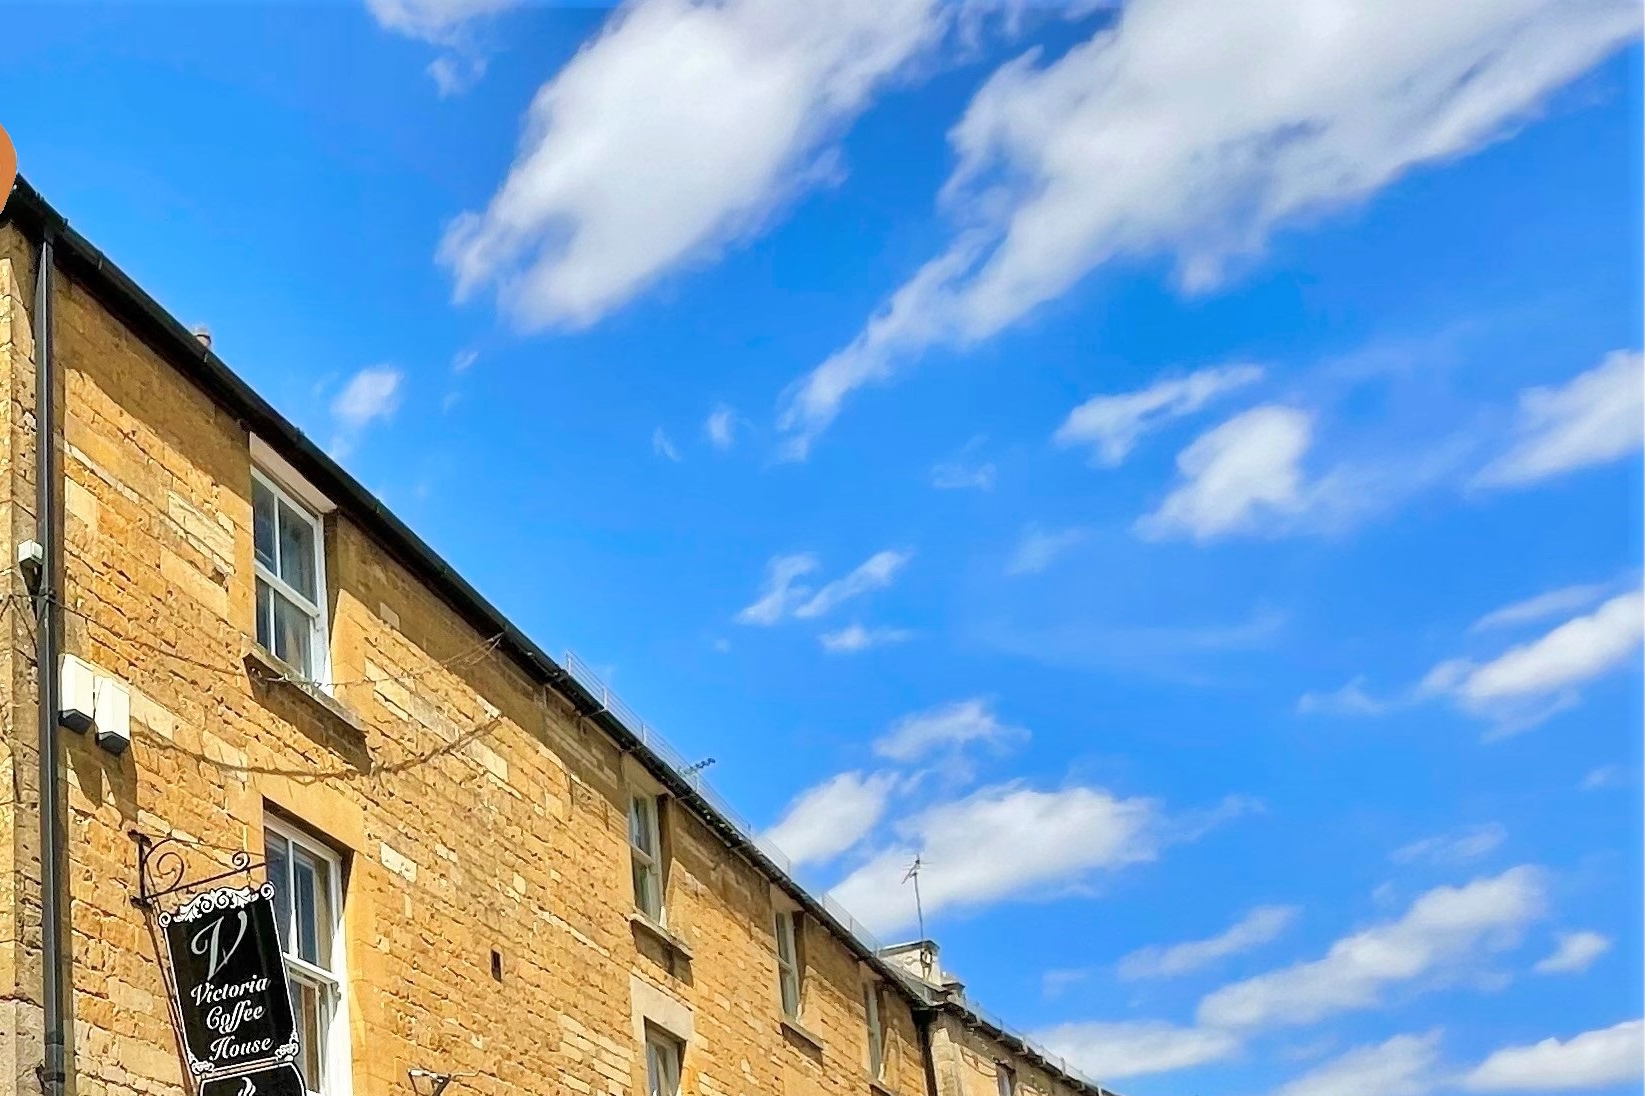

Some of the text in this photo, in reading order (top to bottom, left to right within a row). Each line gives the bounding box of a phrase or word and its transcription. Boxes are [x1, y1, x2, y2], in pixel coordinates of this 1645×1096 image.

[190, 974, 272, 1007] Victoria
[206, 999, 265, 1035] Coffee
[208, 1035, 274, 1062] House
